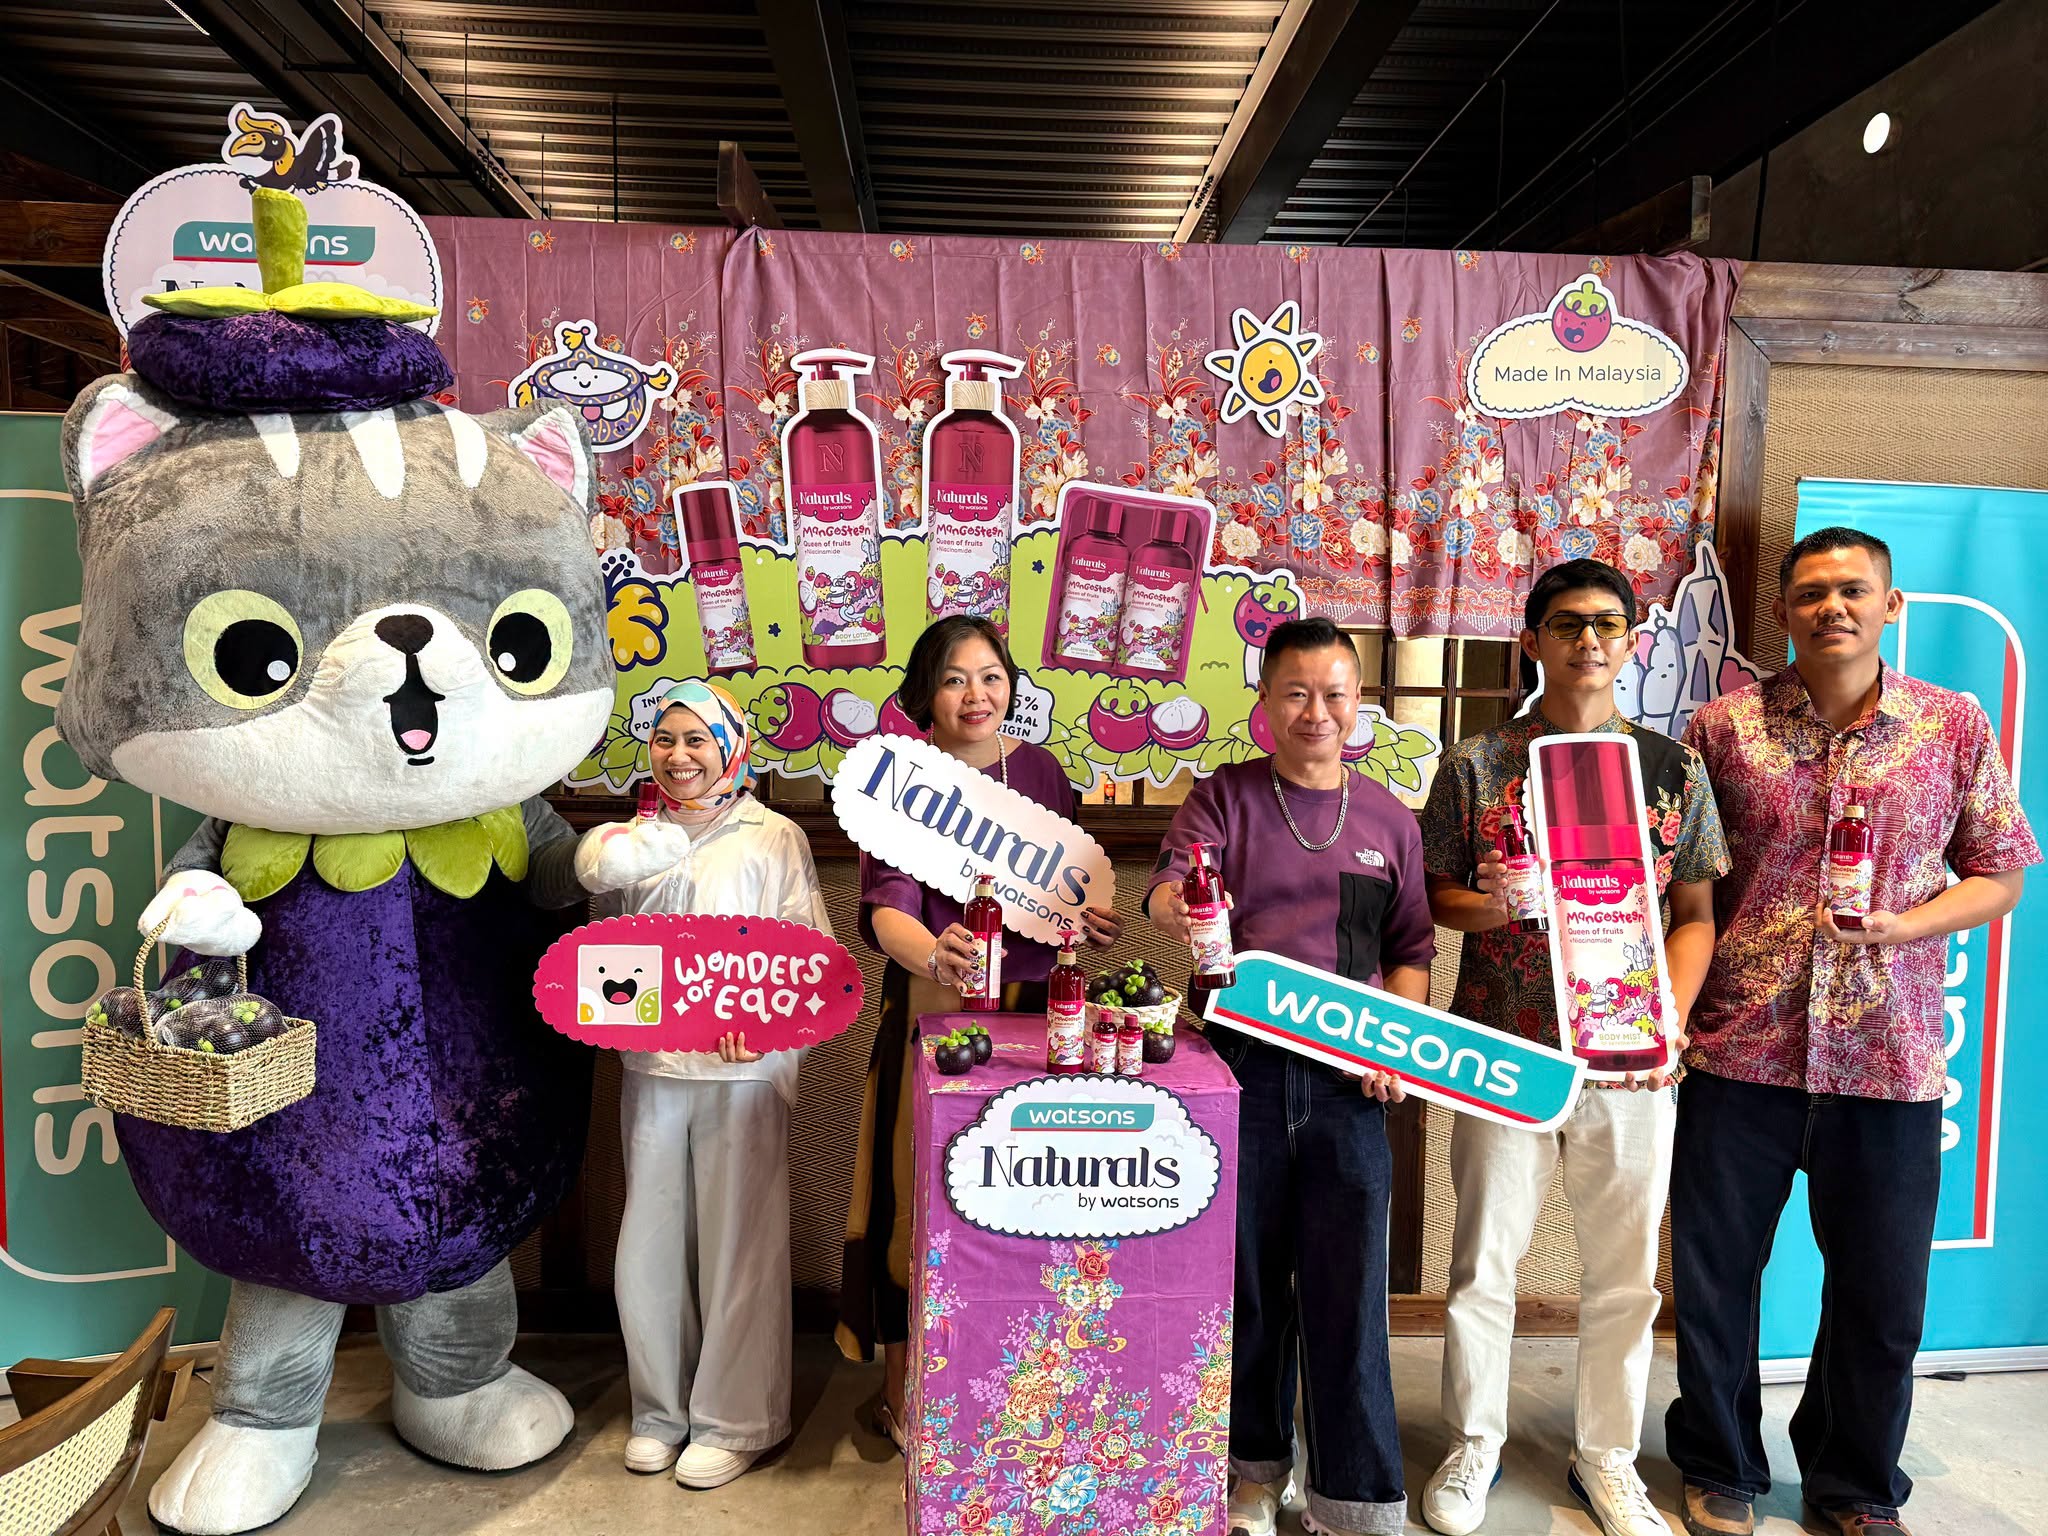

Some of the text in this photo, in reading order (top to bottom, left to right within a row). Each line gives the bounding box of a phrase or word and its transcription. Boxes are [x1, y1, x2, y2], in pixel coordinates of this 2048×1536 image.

[199, 231, 349, 256] wans
[1495, 364, 1661, 384] Made In Malaysia
[800, 491, 852, 505] Naturals
[937, 489, 988, 505] Naturals
[936, 538, 955, 546] Queen
[1014, 694, 1039, 711] 5%
[998, 724, 1031, 737] IGIN
[857, 745, 1091, 907] Naturals
[1561, 874, 1620, 889] Naturals
[1567, 927, 1624, 935] Queen of fruits
[714, 985, 800, 1024] Eqa
[1267, 979, 1522, 1097] watsons
[1029, 1108, 1136, 1125] watsons
[978, 1145, 1181, 1189] Naturals
[1078, 1193, 1179, 1212] by watsons
